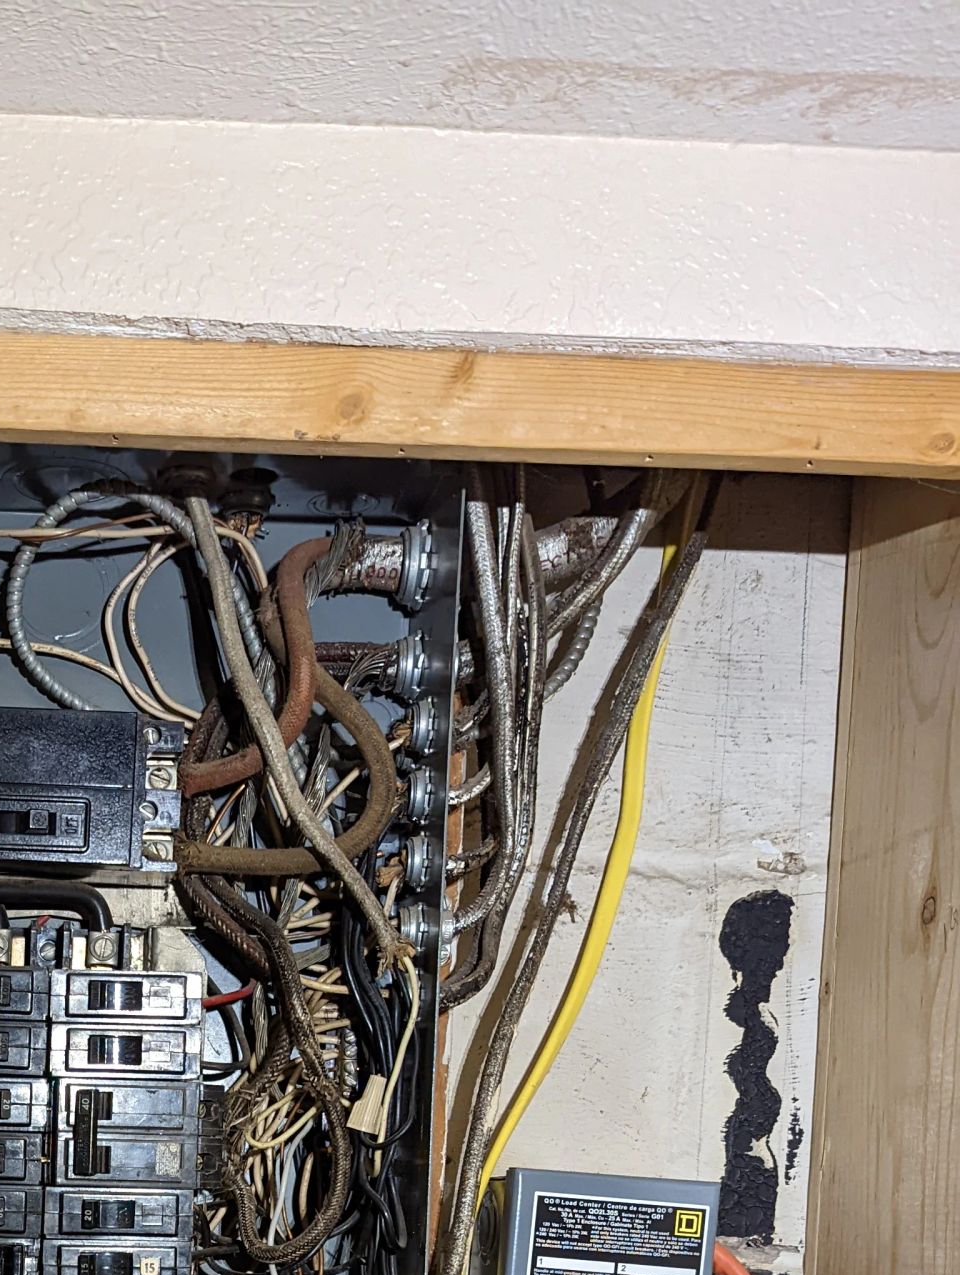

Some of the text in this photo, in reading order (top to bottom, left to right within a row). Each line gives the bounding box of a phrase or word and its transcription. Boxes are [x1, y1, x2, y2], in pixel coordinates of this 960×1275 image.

[64, 816, 78, 835] OFF
[3, 1099, 10, 1110] 20
[81, 1098, 90, 1111] 40
[83, 1209, 92, 1221] 20
[80, 1263, 89, 1273] 15
[144, 1262, 155, 1274] 15
